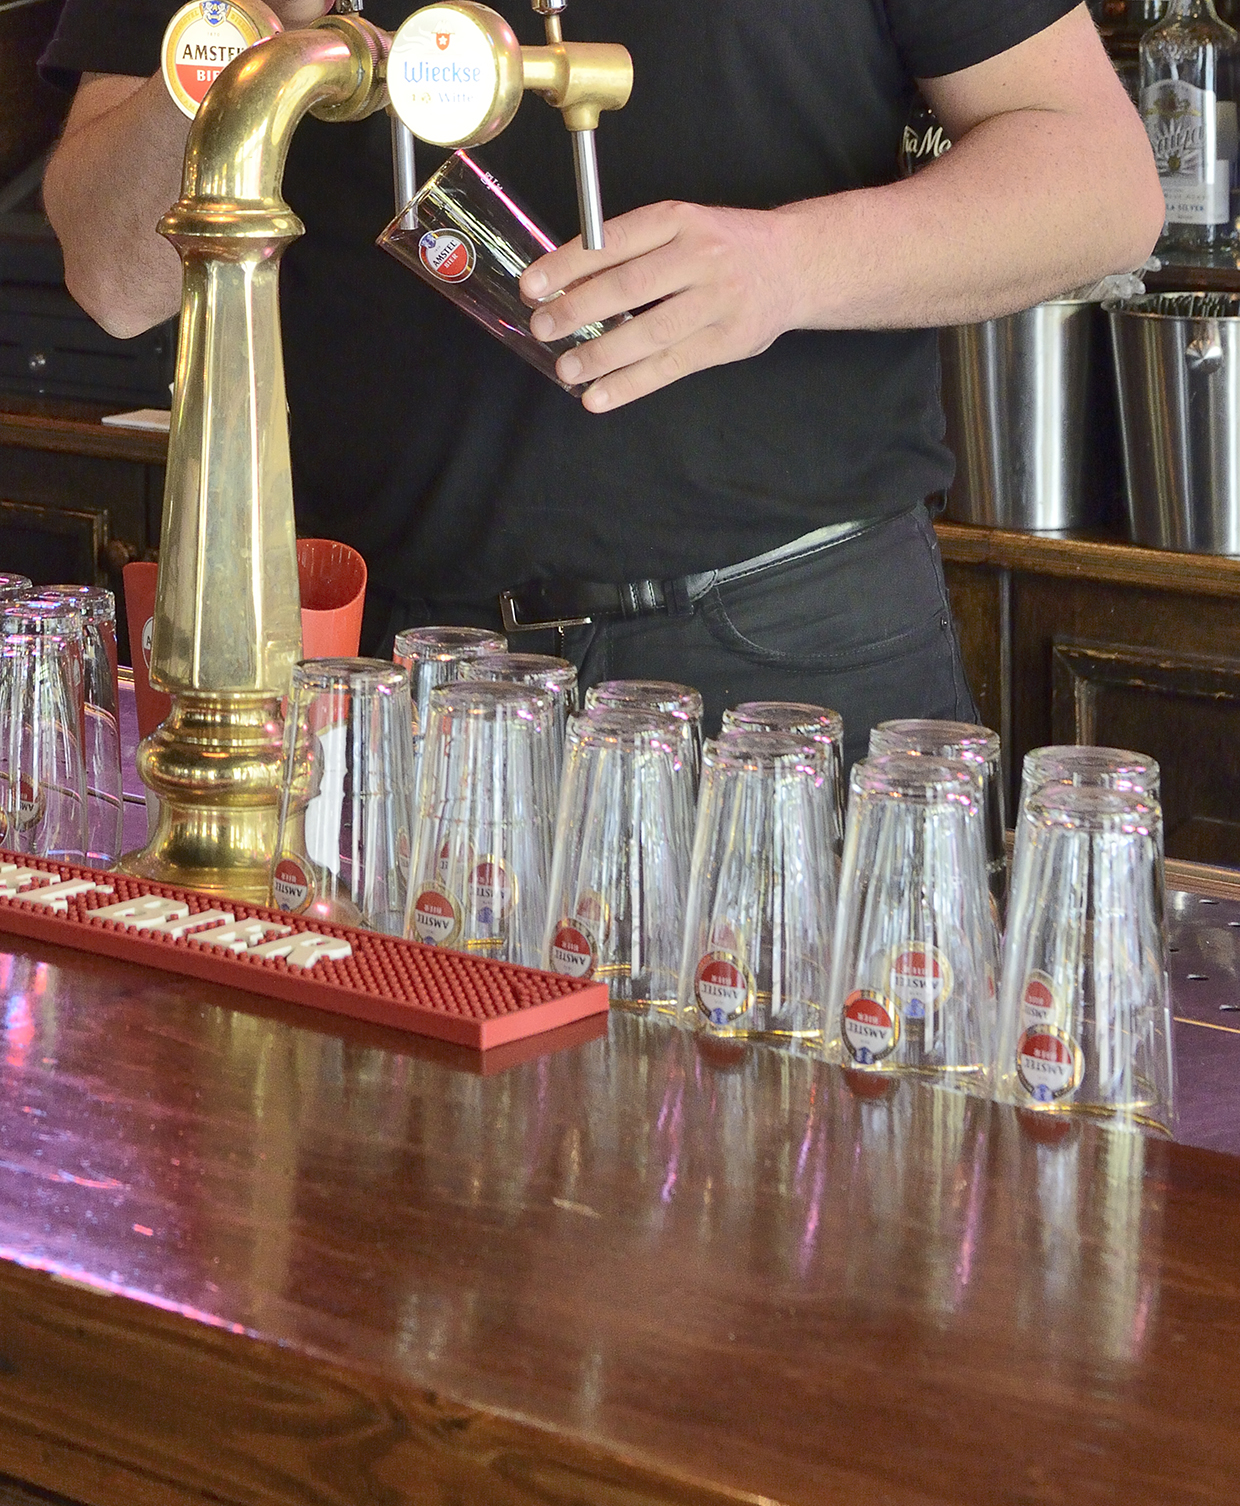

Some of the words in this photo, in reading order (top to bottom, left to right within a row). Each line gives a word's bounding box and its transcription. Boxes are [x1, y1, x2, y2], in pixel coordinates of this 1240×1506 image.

[182, 44, 244, 61] AMSTE
[197, 69, 221, 81] BIE
[404, 61, 481, 83] Wieckse
[432, 239, 458, 267] AMSTEL
[444, 253, 459, 268] BIER
[275, 881, 303, 898] AMSTEL
[417, 914, 450, 929] AMSTEL
[87, 894, 354, 969] BIER
[555, 948, 587, 966] AMSTEL
[702, 983, 738, 999] AMSTEL
[848, 1021, 887, 1039] AMSTEL
